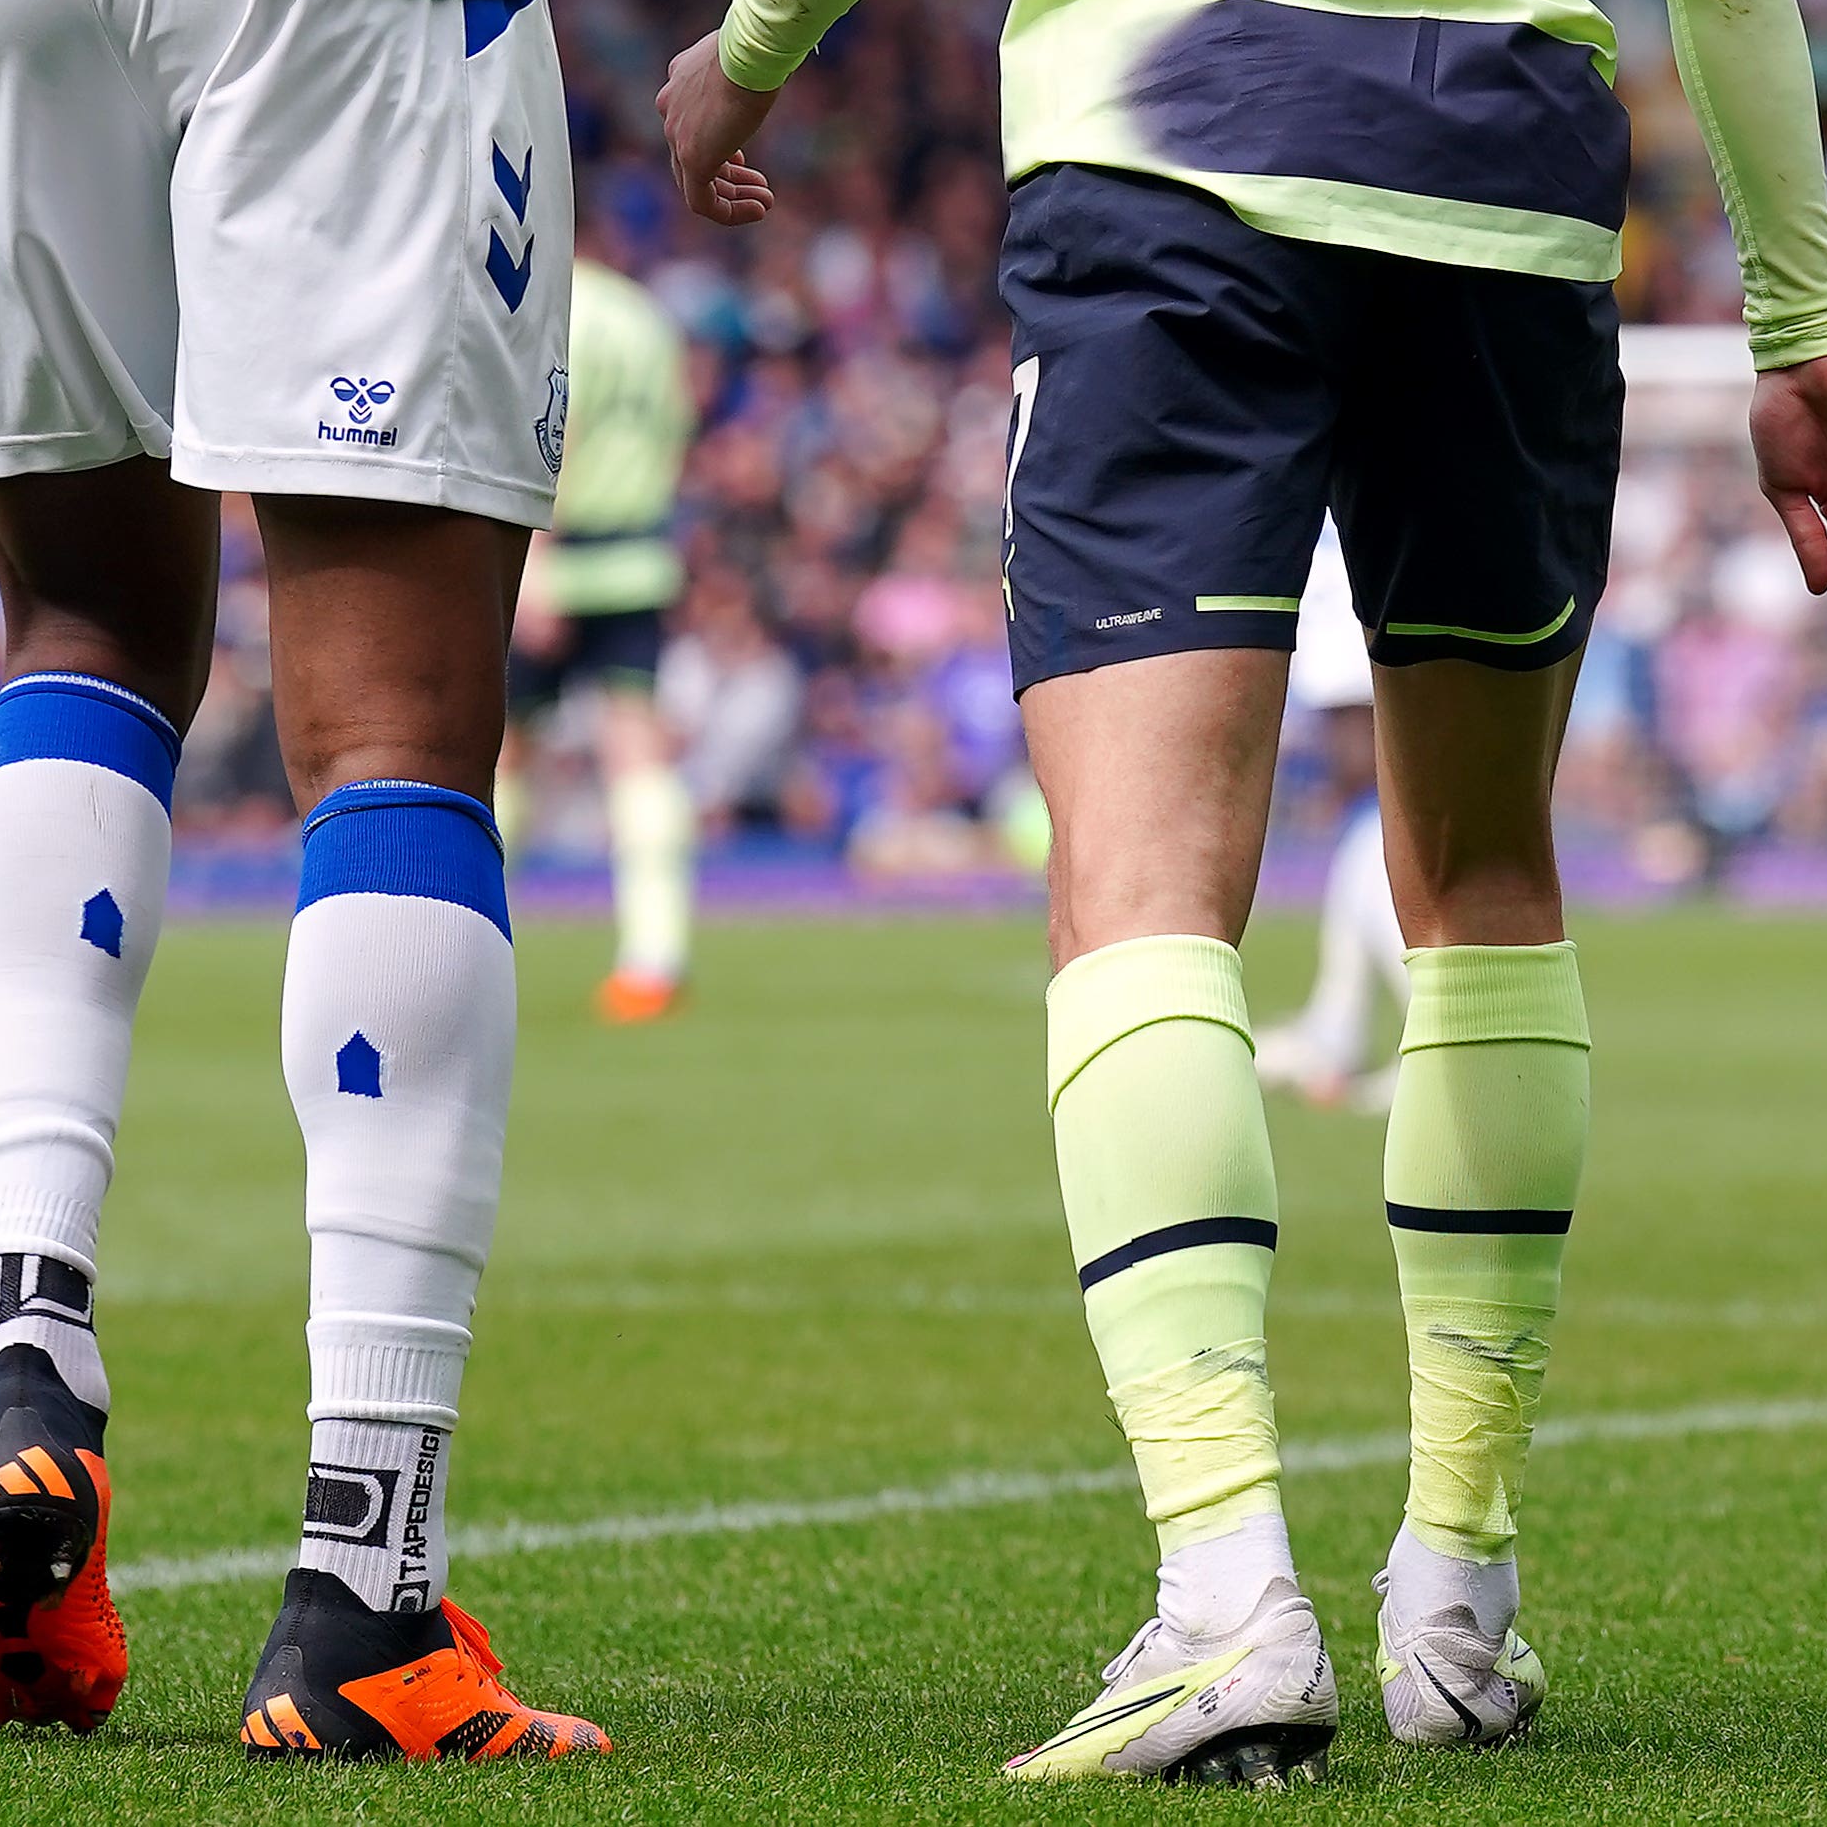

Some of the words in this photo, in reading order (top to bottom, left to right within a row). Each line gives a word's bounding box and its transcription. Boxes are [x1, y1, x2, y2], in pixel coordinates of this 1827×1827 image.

[317, 420, 398, 447] hummel
[1003, 354, 1040, 540] 7
[1095, 607, 1162, 630] ULTRAWEAVE
[1300, 1636, 1326, 1704] PHANT
